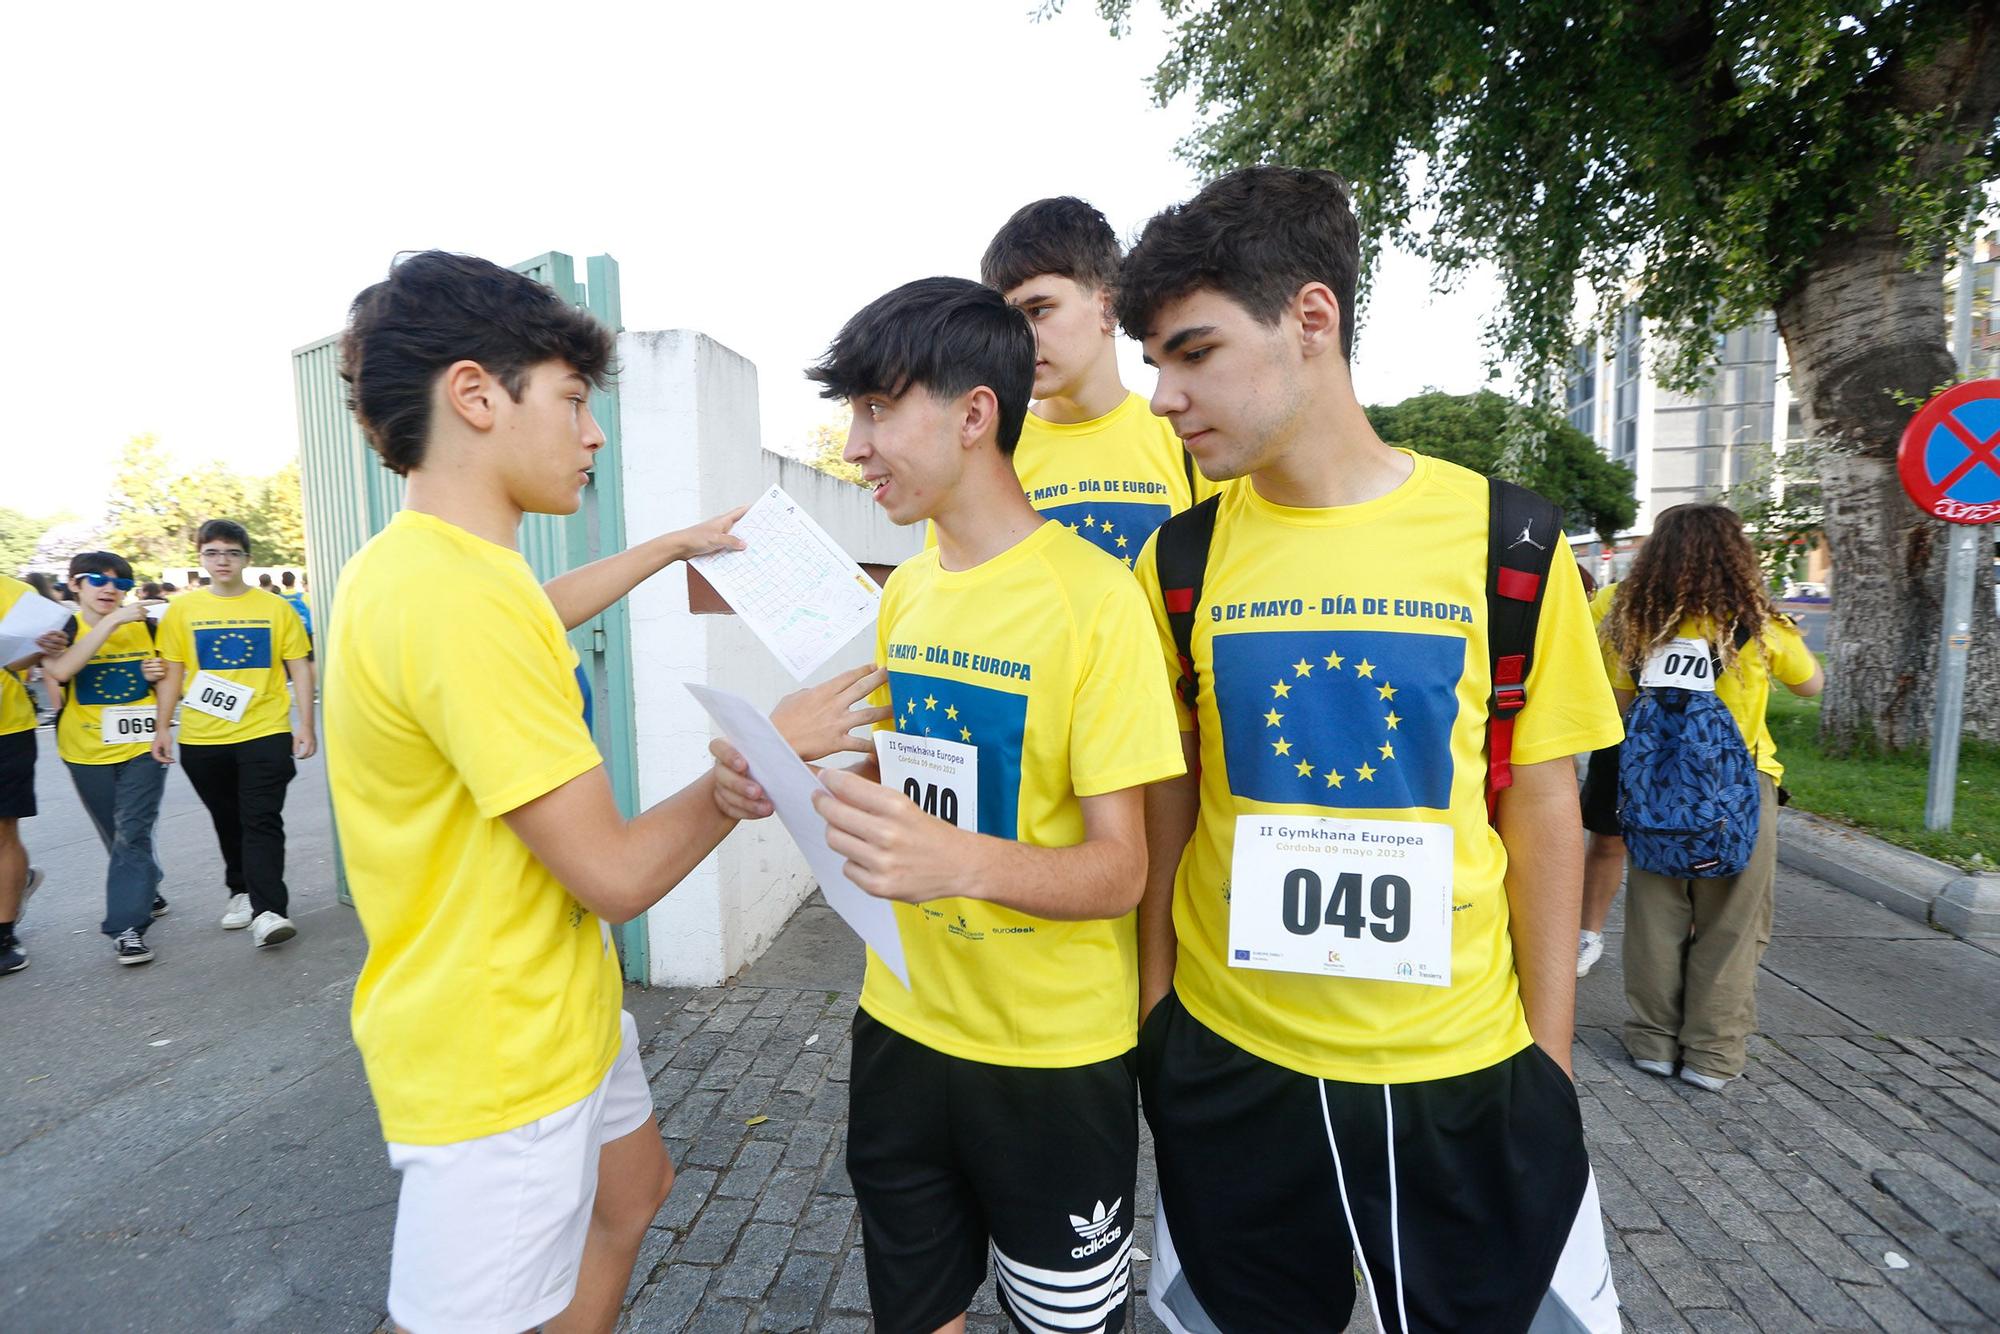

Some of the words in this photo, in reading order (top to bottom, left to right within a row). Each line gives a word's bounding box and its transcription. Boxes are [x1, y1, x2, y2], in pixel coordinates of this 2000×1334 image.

[1034, 483, 1068, 500] MAYO
[1079, 479, 1100, 492] DÍA
[1104, 480, 1119, 492] DE
[1211, 605, 1222, 622] 9
[1226, 603, 1246, 620] DE
[1250, 599, 1303, 618] MAYO
[1321, 594, 1357, 615] DÍA
[1363, 598, 1388, 615] DE
[1394, 599, 1473, 623] EUROPA
[896, 644, 918, 660] MAYO
[925, 645, 949, 664] DÍA
[952, 650, 970, 669] DE
[972, 654, 1031, 681] EUROPA
[1664, 653, 1708, 679] 070
[201, 687, 237, 711] 069
[118, 717, 156, 734] 069
[889, 741, 896, 750] II
[898, 742, 935, 758] Gymkhana
[937, 750, 965, 765] Europea
[1260, 826, 1273, 837] II
[1278, 826, 1356, 842] Gymkhana
[1361, 832, 1424, 847] Europea
[1276, 842, 1321, 853] Córdoba
[1324, 845, 1339, 854] 09
[1342, 847, 1373, 858] mayo
[1376, 848, 1406, 858] 2023
[1282, 868, 1412, 943] 049
[992, 926, 1036, 934] eurodesk
[1071, 1226, 1121, 1259] adidas
